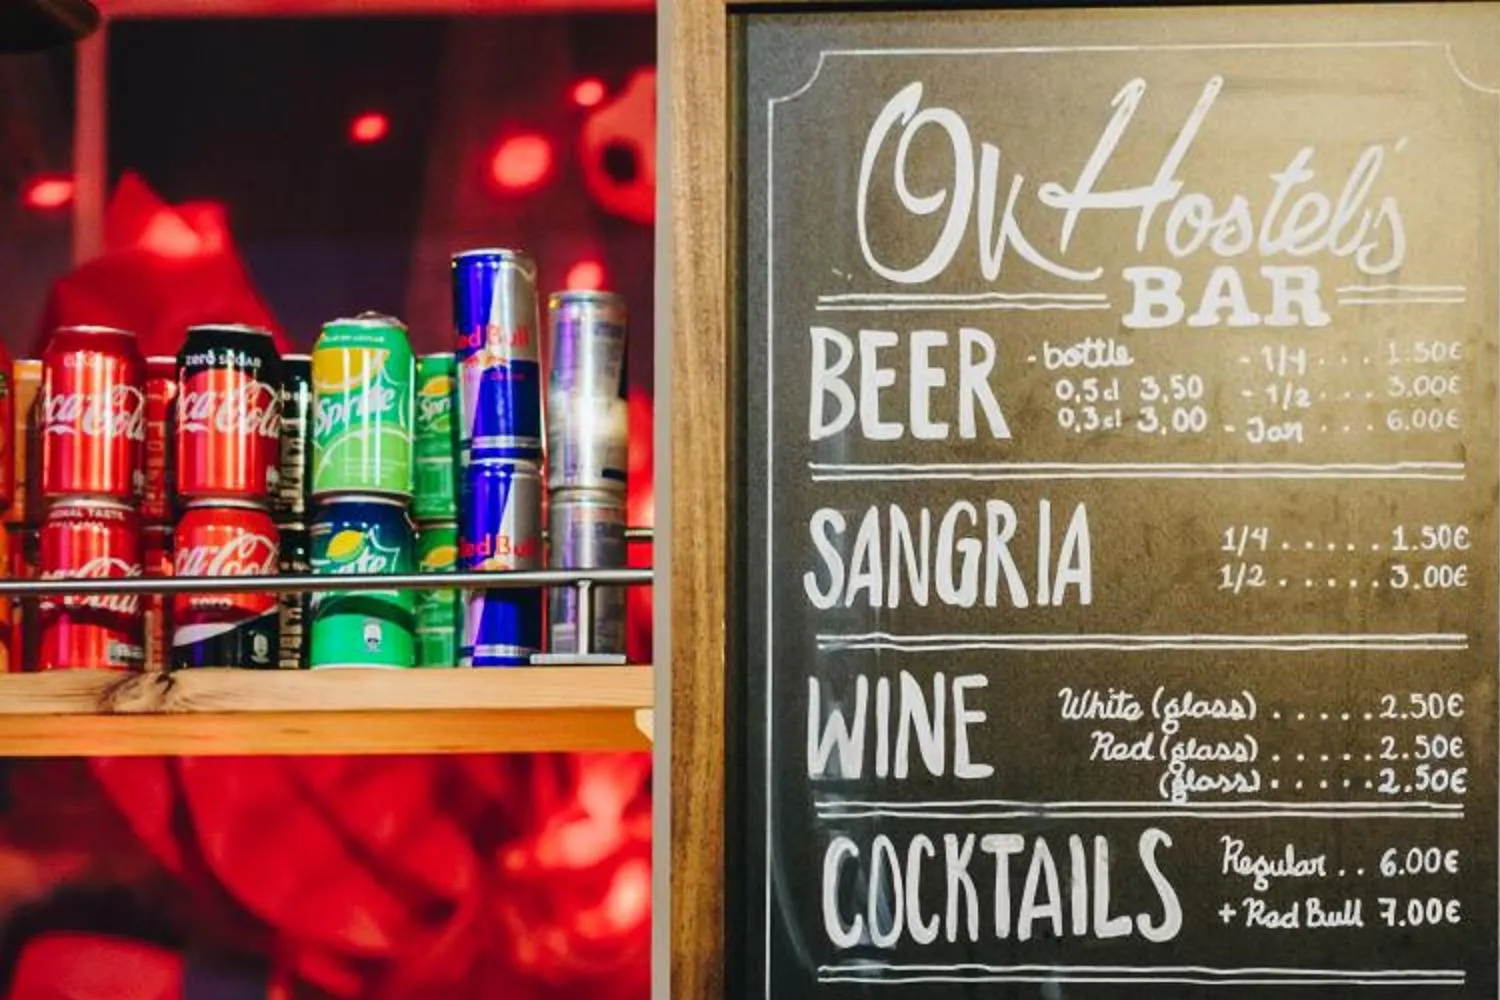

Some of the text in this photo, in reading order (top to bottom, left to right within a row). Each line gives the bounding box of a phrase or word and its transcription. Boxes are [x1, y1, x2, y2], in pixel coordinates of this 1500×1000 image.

[858, 81, 1103, 283] Ok
[1122, 266, 1331, 328] BAR
[1044, 336, 1134, 370] bottle
[1389, 341, 1462, 365] 1.50€
[809, 327, 1011, 441] BEER
[1265, 375, 1461, 410] 1/2 3.00€
[1387, 409, 1460, 431] 6.00€
[803, 500, 1093, 608] SANGRIA
[1221, 525, 1470, 557] 1/4 1.50€
[1218, 562, 1468, 594] 1/2 3.00€
[1058, 688, 1144, 720] White
[1380, 693, 1464, 720] 2.50€
[807, 671, 994, 781] WINE
[1090, 730, 1154, 761] Red
[1380, 735, 1464, 761] 2.50€
[1378, 765, 1467, 794] 2.50€
[1220, 835, 1459, 891] Regular 6.00€
[822, 828, 1183, 948] COCKTAILS
[1242, 897, 1299, 928] Red
[1306, 897, 1364, 927] Bull
[1377, 897, 1461, 927] 7.00€
